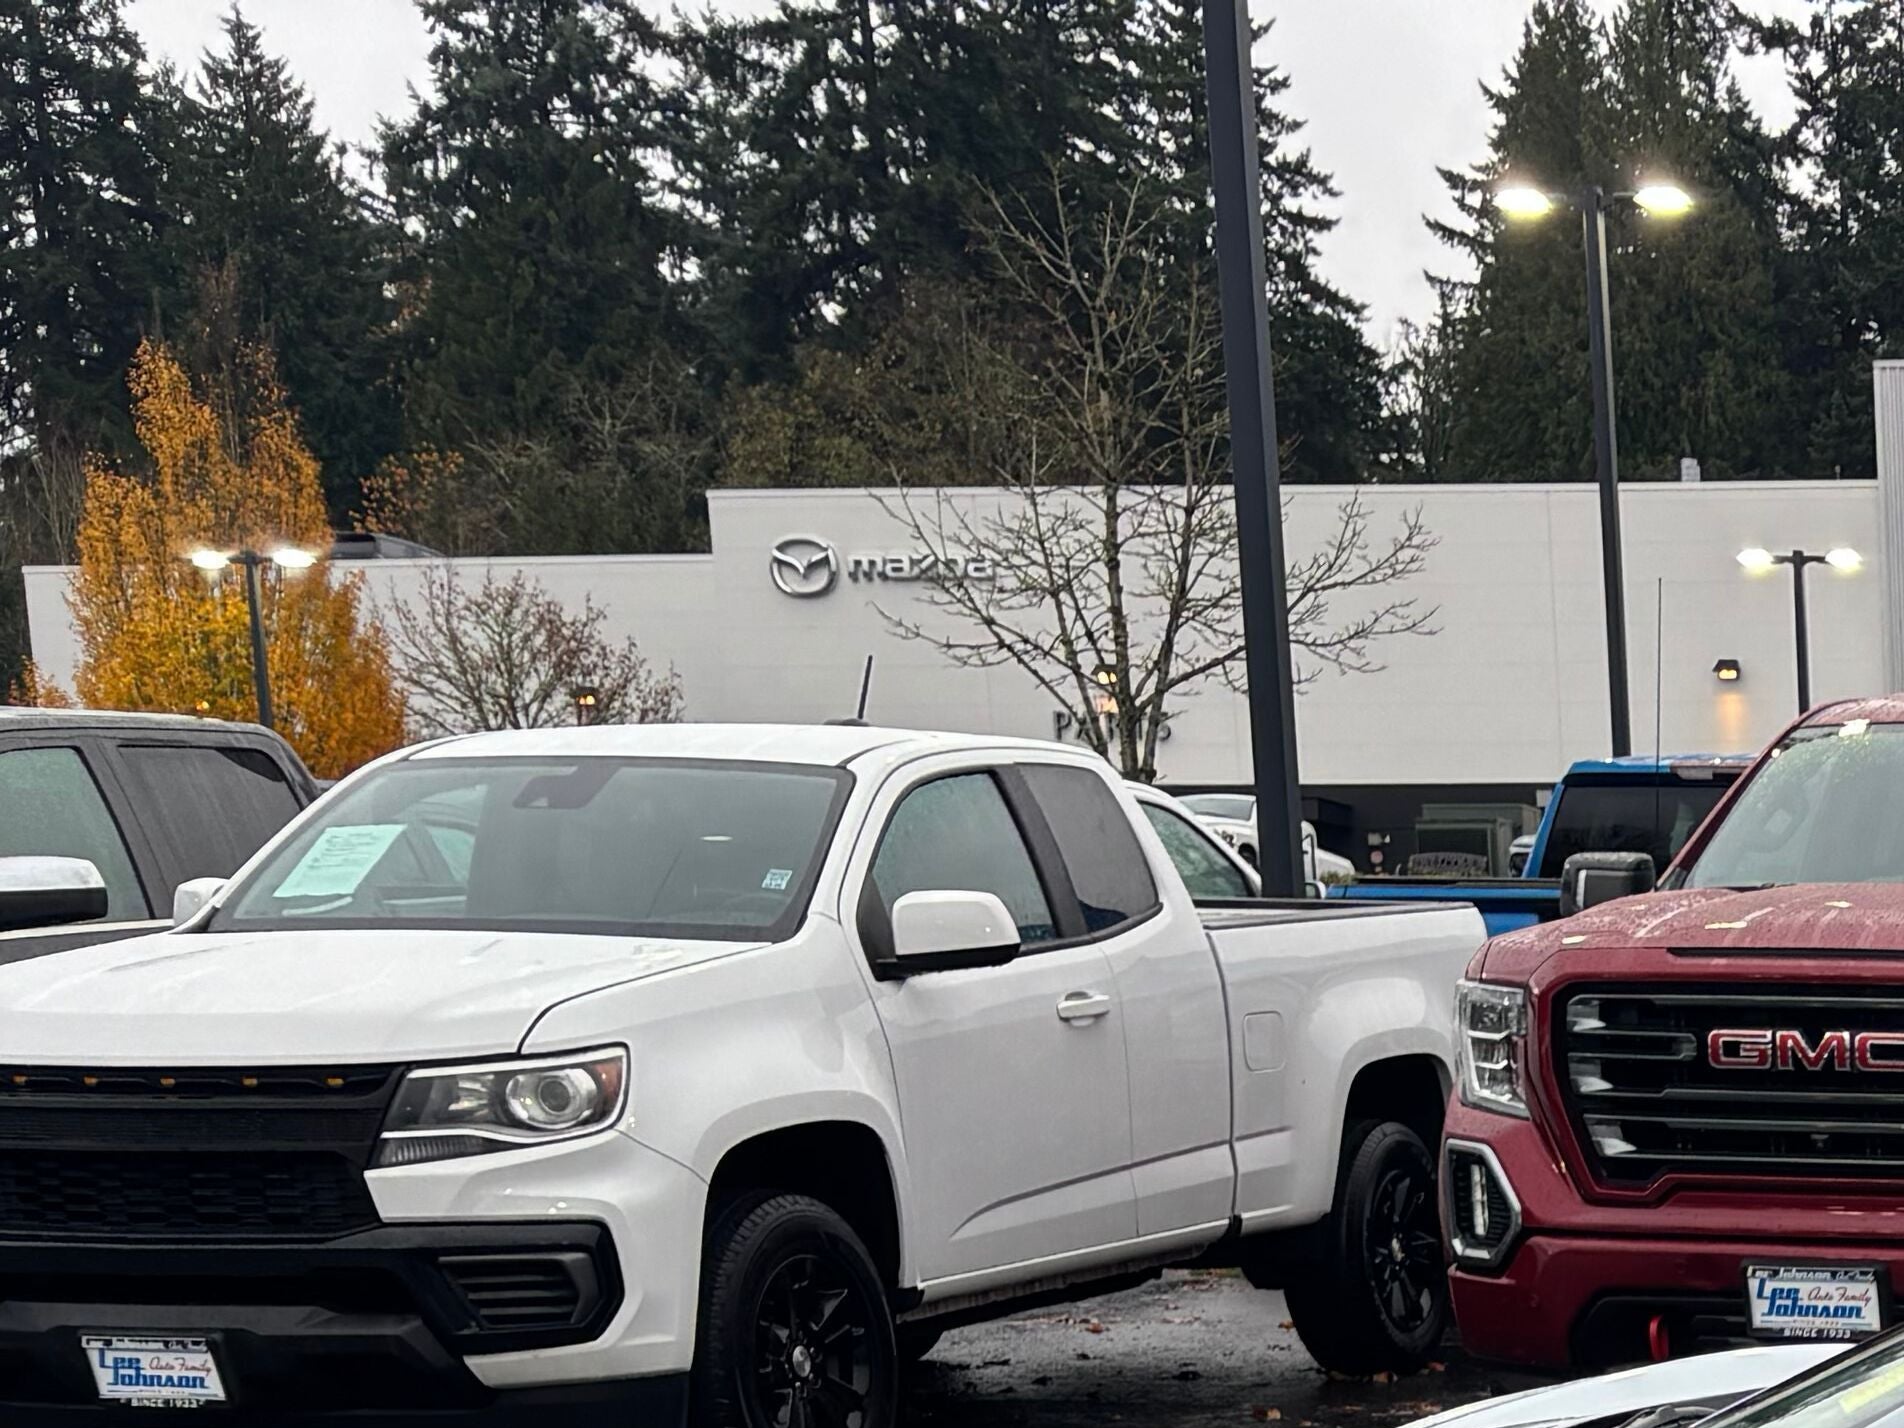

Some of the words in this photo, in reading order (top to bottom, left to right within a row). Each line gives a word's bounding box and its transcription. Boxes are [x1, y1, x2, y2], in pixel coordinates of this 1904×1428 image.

[1756, 1278, 1804, 1300] Lee
[1835, 1286, 1873, 1308] Family
[1761, 1299, 1866, 1319] Johnson
[98, 1348, 146, 1370] Lee
[107, 1368, 211, 1389] Johnson
